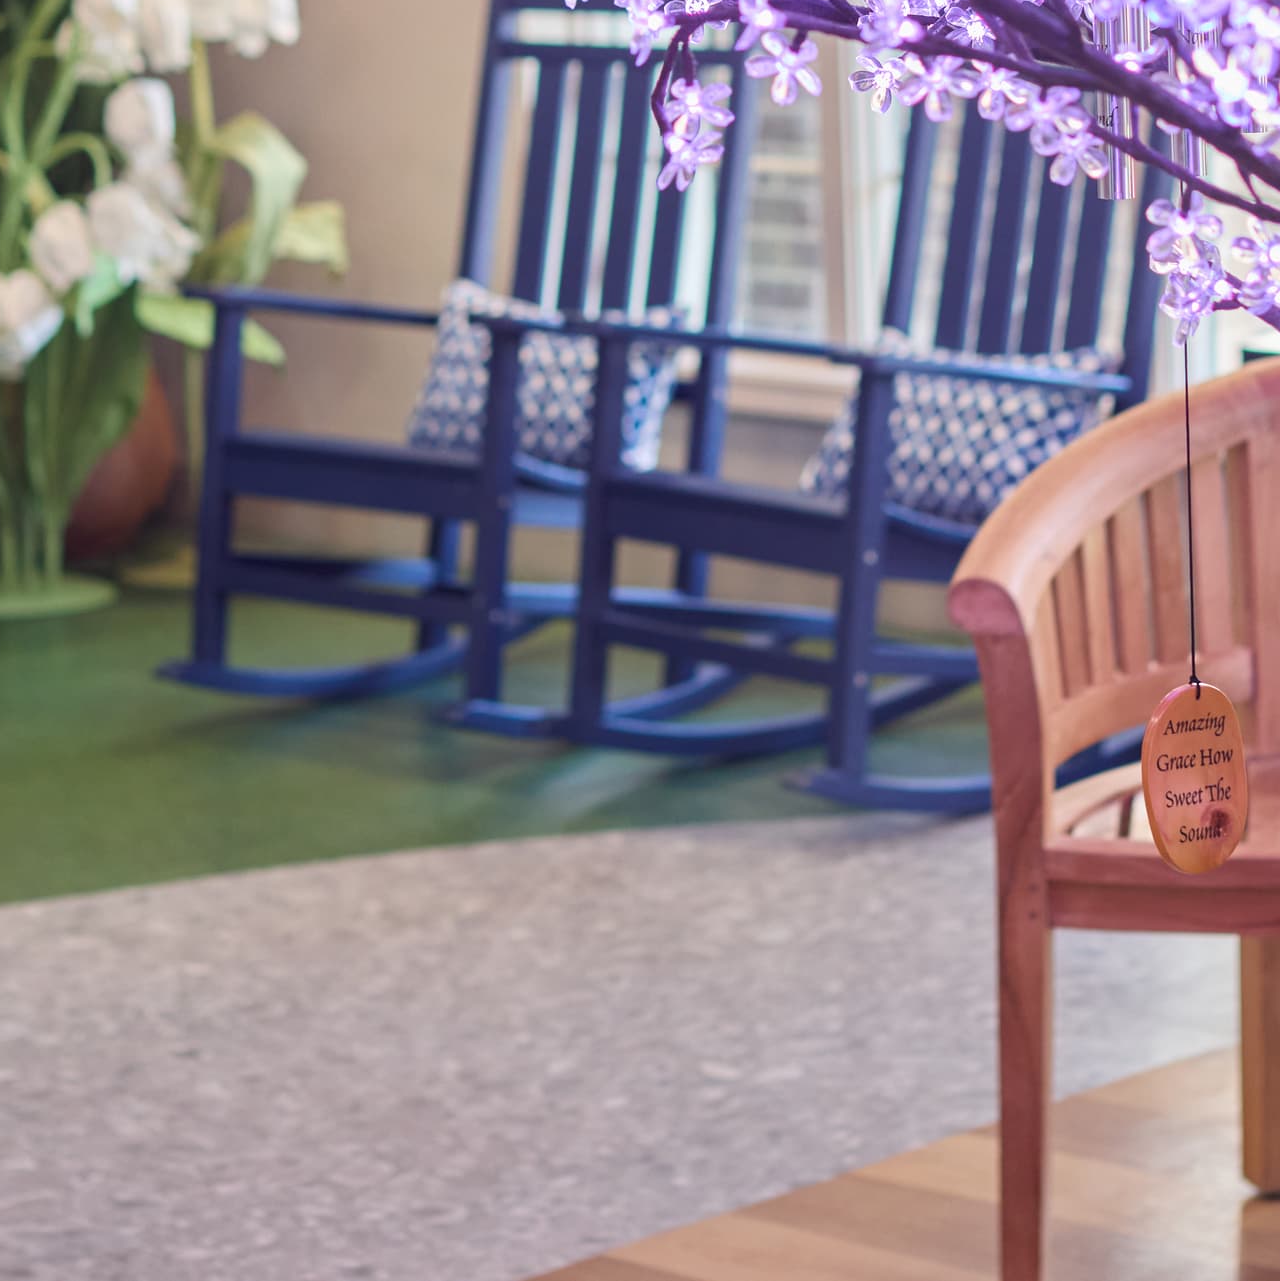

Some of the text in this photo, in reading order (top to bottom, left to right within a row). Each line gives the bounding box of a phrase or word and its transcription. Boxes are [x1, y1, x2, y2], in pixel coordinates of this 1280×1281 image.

[1162, 712, 1225, 737] Amazing
[1156, 748, 1233, 772] Grace How
[1165, 777, 1231, 808] Sweet The
